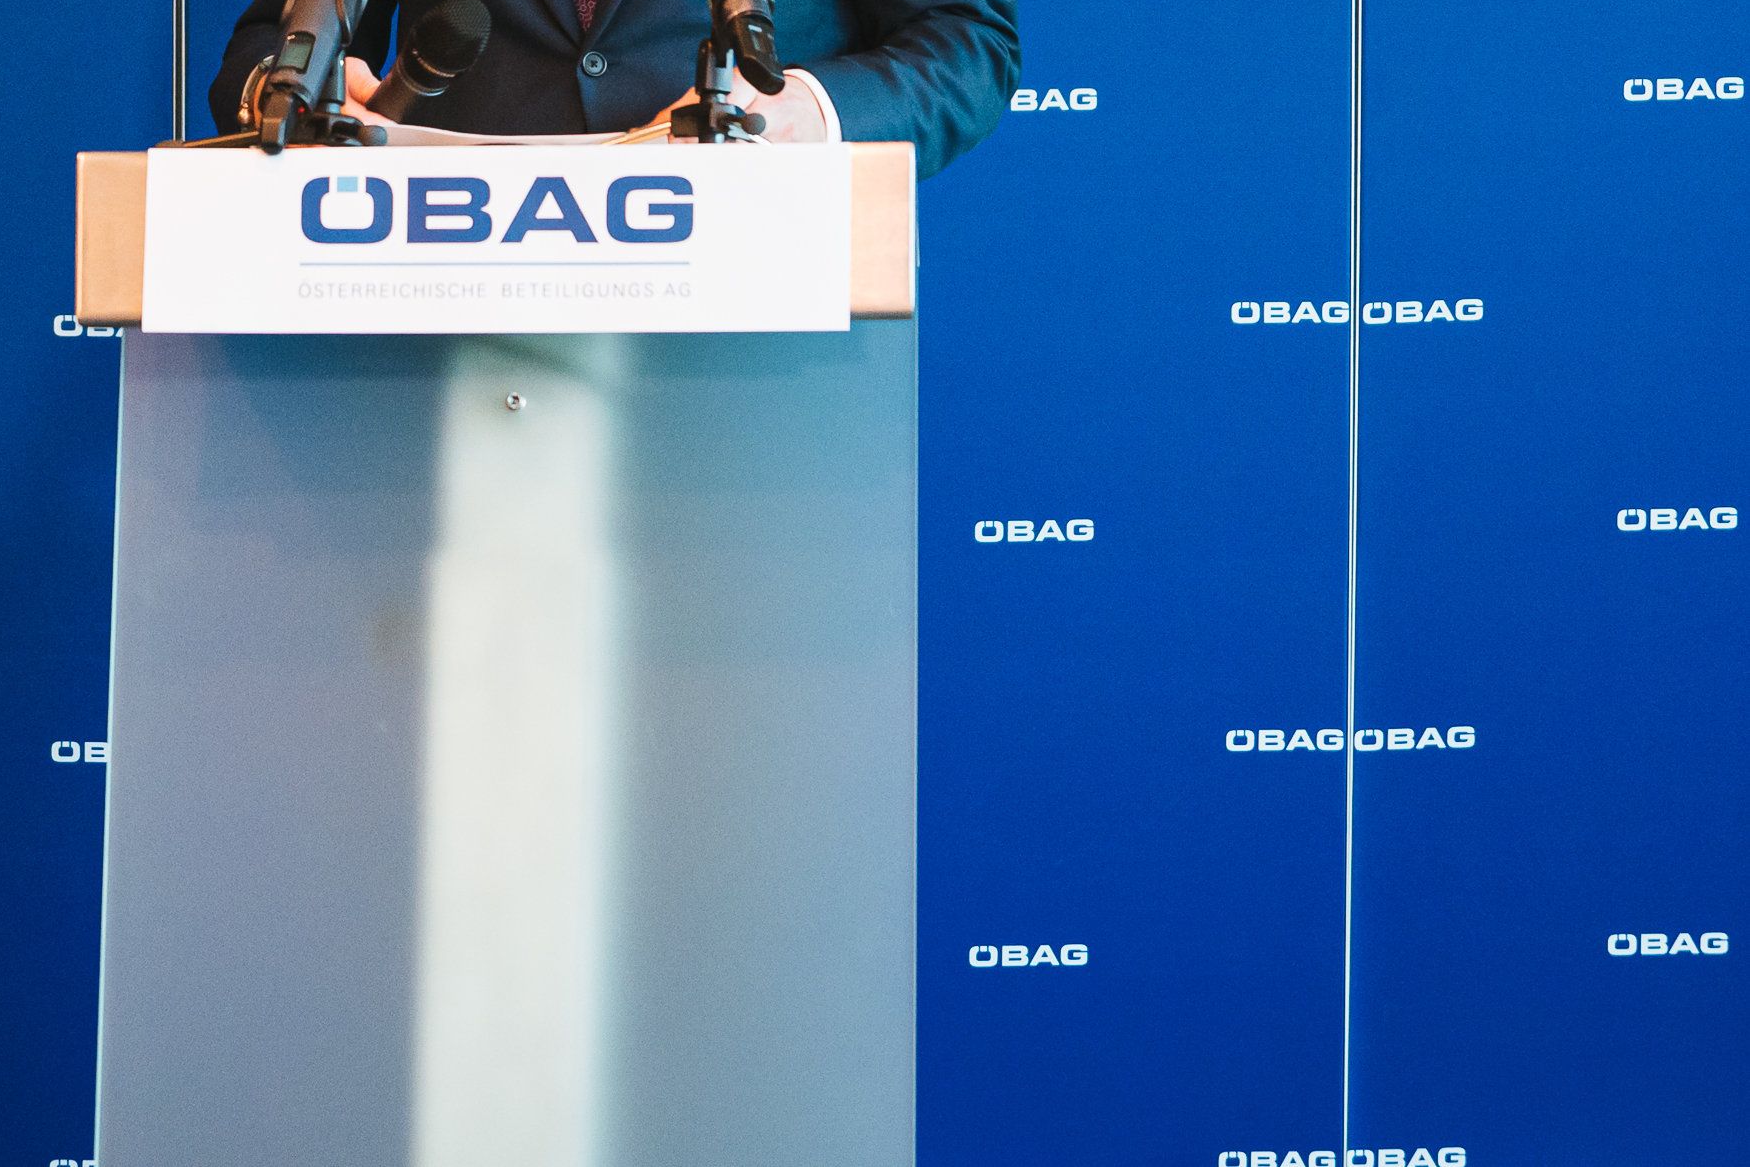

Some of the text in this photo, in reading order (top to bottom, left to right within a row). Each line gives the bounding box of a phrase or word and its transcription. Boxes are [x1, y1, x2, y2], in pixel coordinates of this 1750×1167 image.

[1010, 88, 1097, 112] BAG
[301, 175, 694, 244] ÖBAG
[298, 279, 693, 299] ÖSTERREICHISCHE BETEILIGUNGS AG
[51, 740, 108, 763] ÖB
